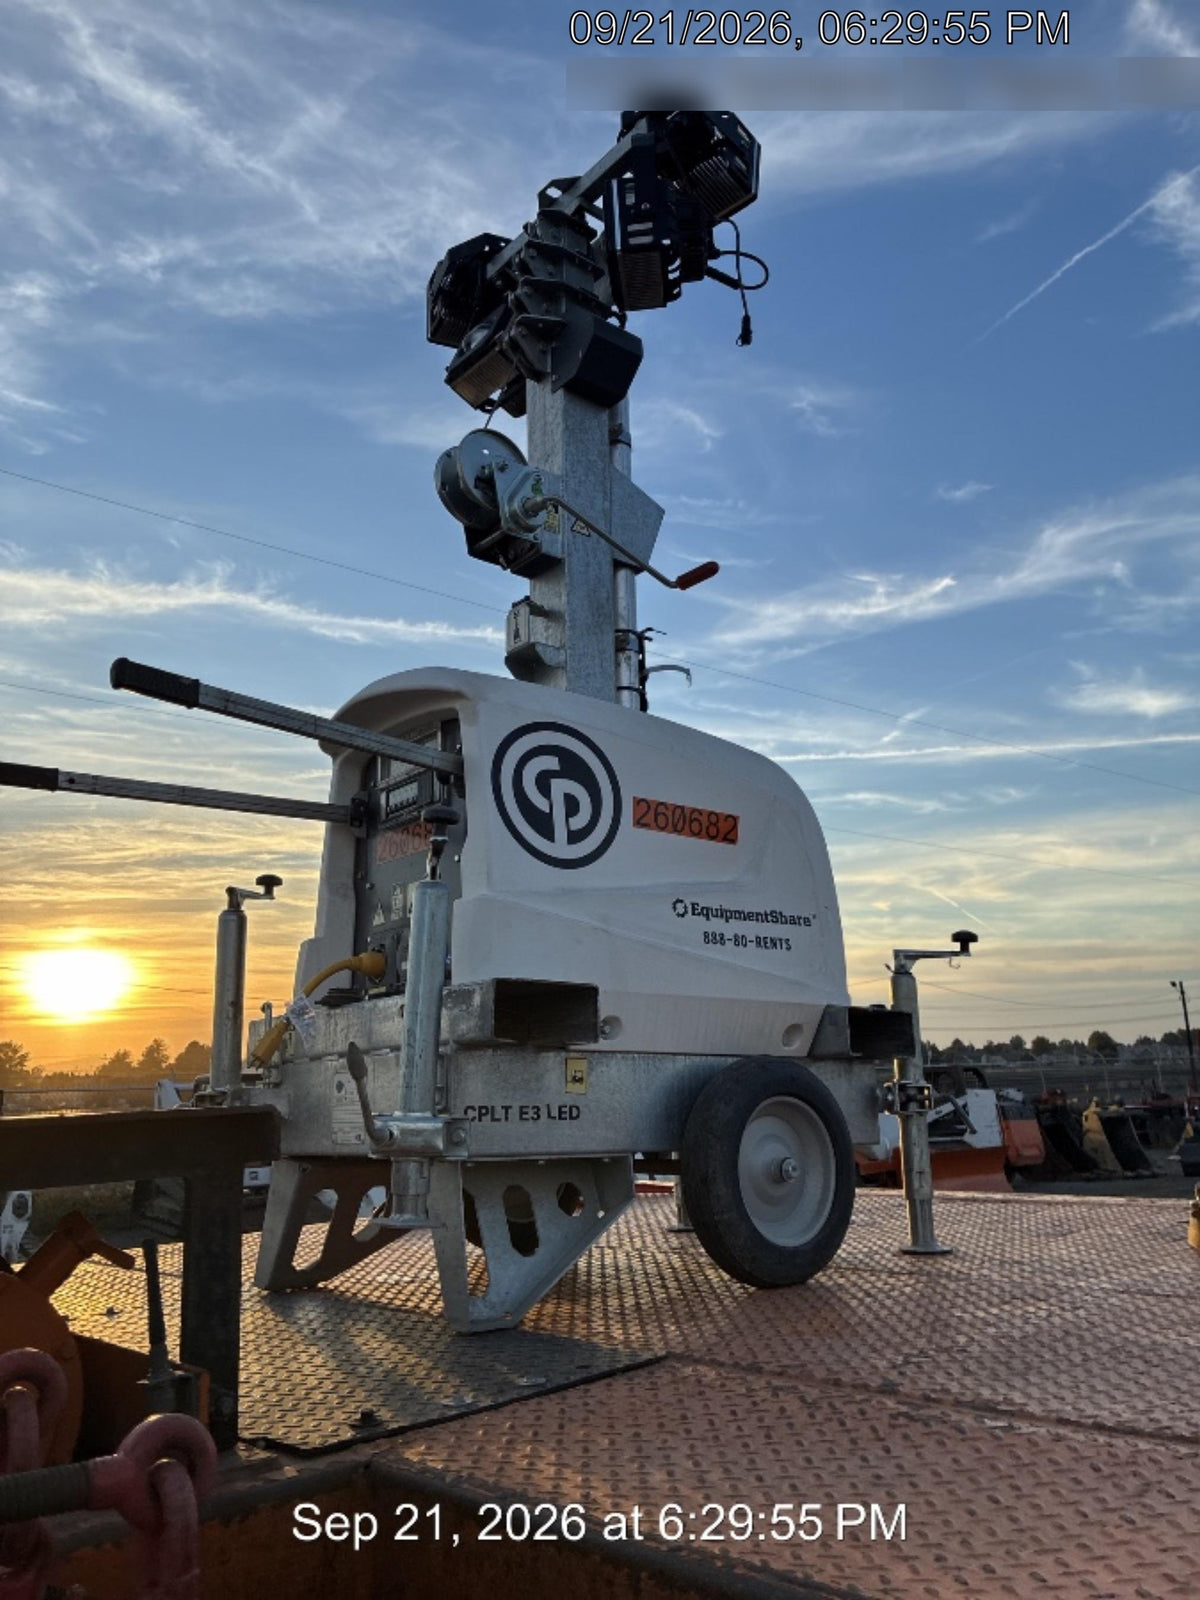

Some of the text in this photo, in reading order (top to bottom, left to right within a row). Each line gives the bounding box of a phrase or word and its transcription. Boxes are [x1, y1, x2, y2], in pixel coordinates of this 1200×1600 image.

[635, 797, 739, 844] 260682
[690, 902, 812, 927] EquipmentShare
[703, 931, 792, 951] 888-80-RENTS
[463, 1103, 580, 1122] CPLT E3 LED
